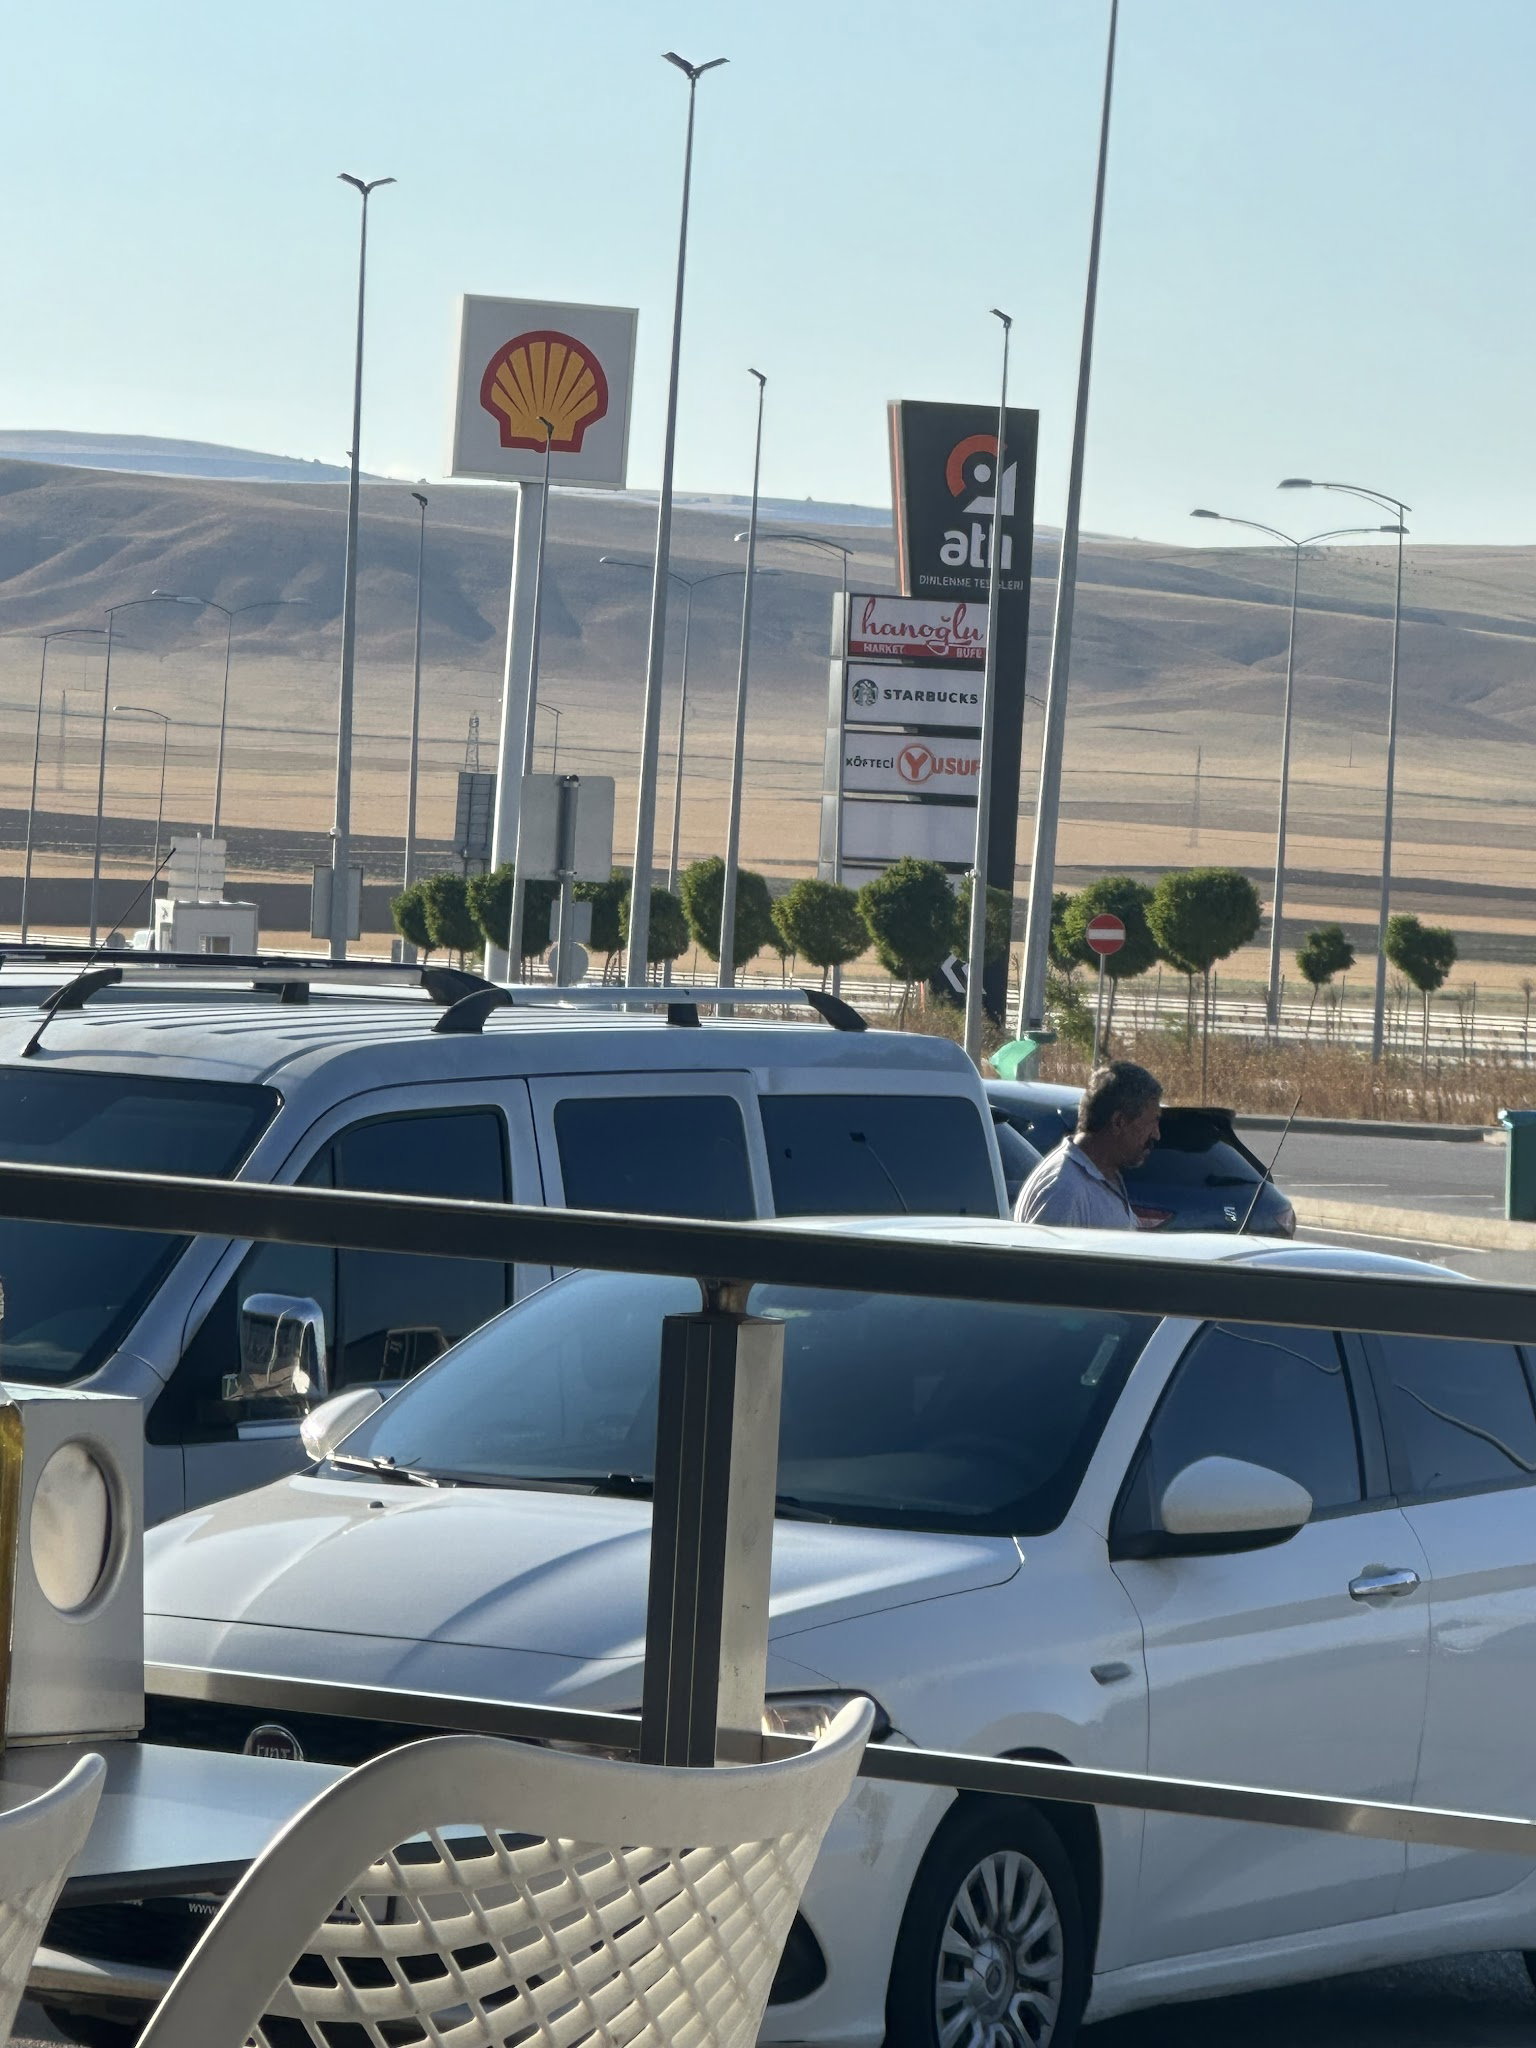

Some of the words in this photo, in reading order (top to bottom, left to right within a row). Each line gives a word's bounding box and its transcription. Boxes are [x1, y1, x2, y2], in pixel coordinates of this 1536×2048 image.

[862, 597, 984, 655] hanoğlu
[863, 643, 905, 655] MARKET
[883, 688, 978, 705] STARBUCKS
